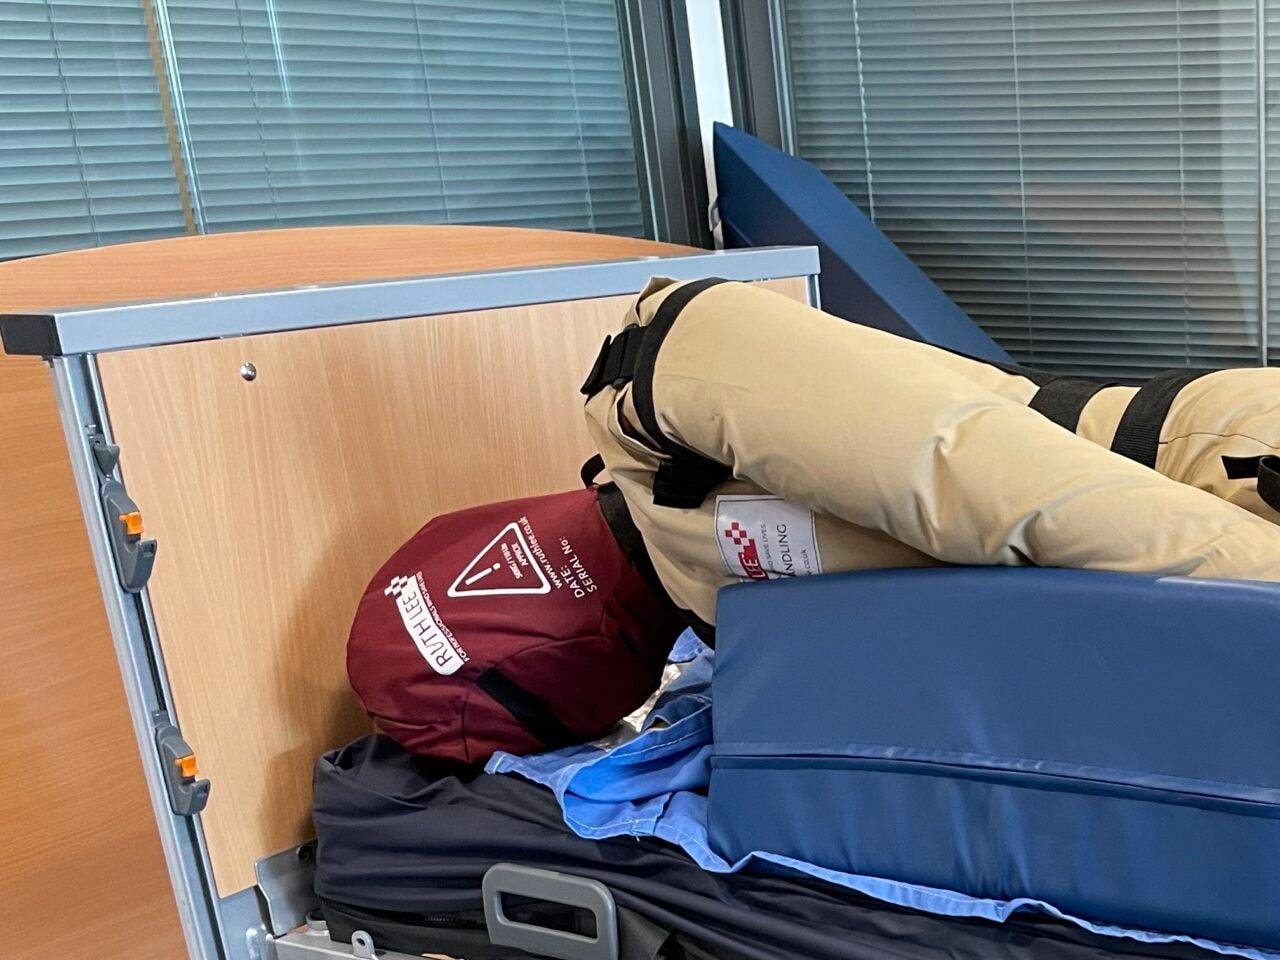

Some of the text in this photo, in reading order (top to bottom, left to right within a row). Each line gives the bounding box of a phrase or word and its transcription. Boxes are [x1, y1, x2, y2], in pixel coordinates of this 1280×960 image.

[518, 516, 563, 589] www.ruthlee.co.uk
[560, 536, 598, 593] SERIAL No:
[777, 523, 796, 575] ANDLING
[560, 565, 586, 599] DATE:
[402, 592, 454, 667] RUTH LEE
